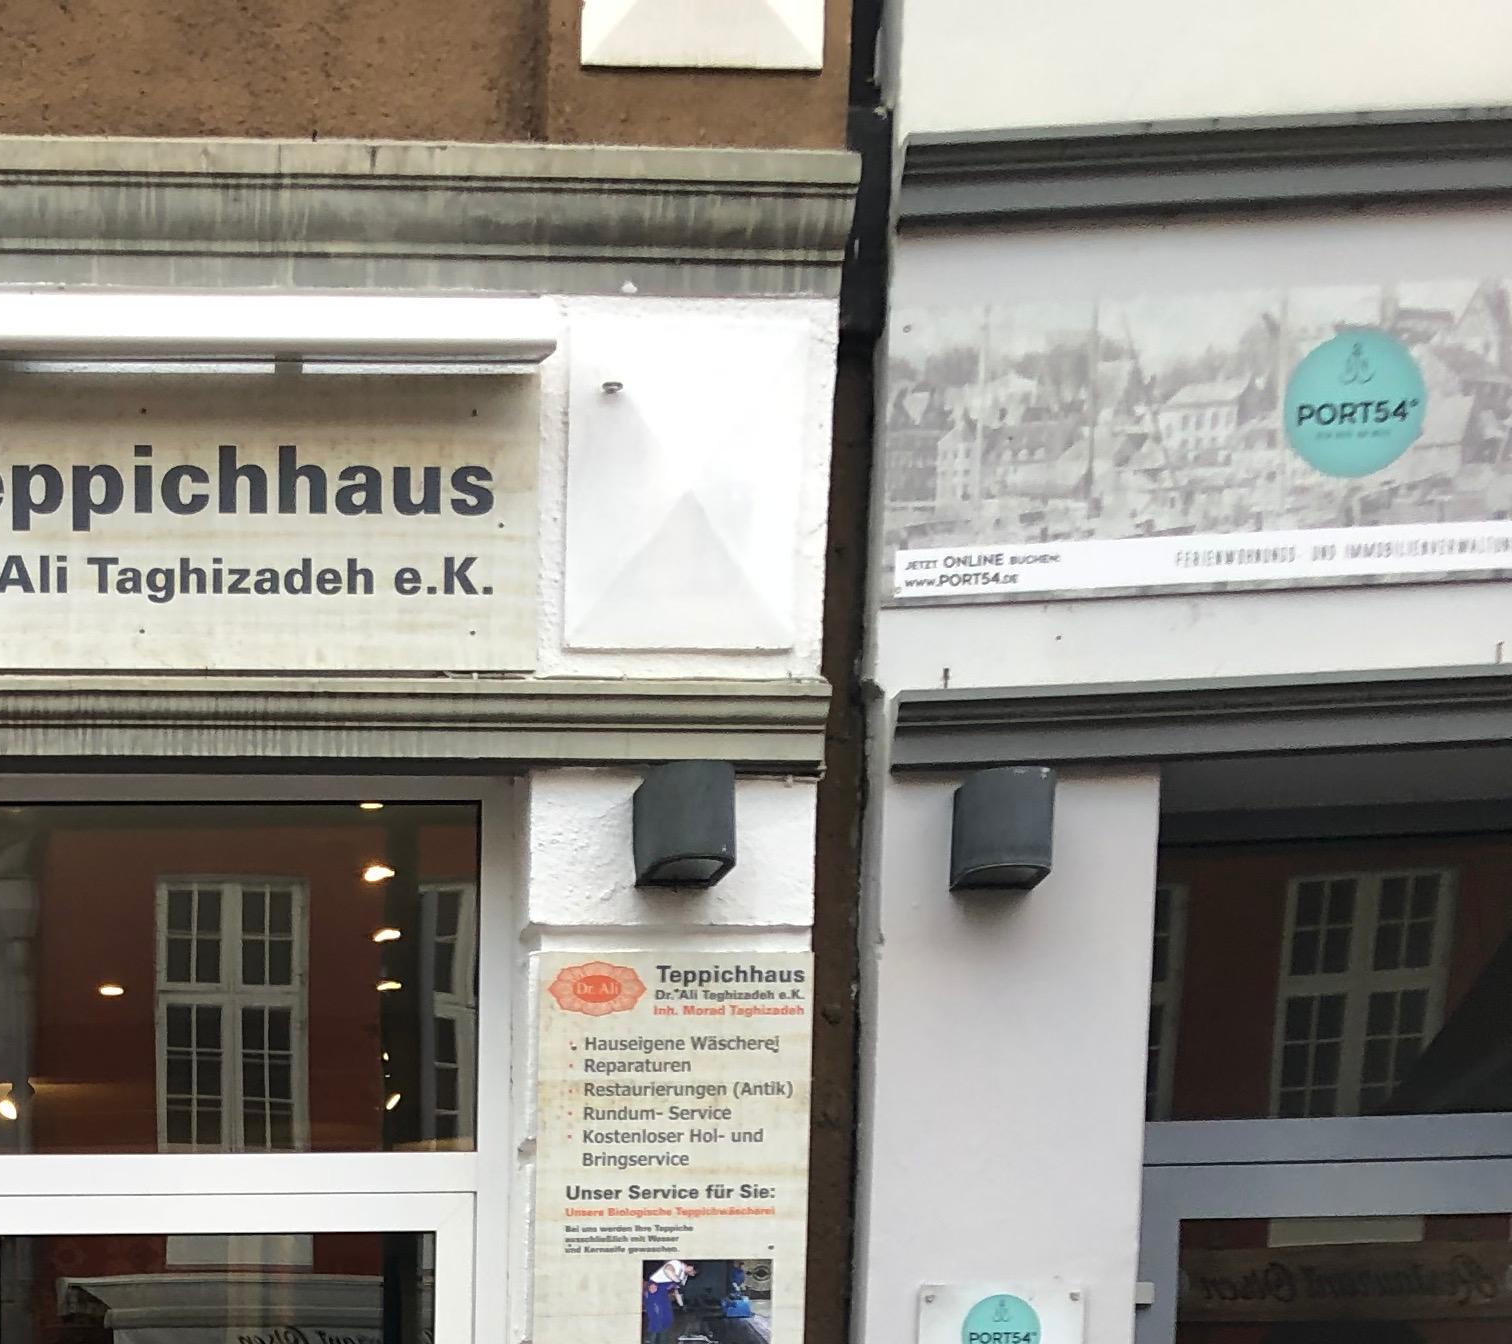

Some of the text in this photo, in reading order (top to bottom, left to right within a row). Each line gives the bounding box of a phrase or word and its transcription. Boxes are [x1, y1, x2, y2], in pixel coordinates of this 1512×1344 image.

[904, 559, 938, 571] JETZT
[943, 553, 1004, 568] ONLINE
[87, 556, 374, 603] Taghizadeh
[394, 556, 494, 595] e.K.
[656, 965, 806, 986] Teppichhaus
[601, 982, 619, 995] Ali
[654, 989, 675, 1000] Dr.
[677, 989, 698, 1000] Ali
[703, 989, 775, 1002] Taghizadeh
[653, 1004, 805, 1018] Inh. Morad Taghizadeh
[584, 1035, 780, 1054] Hauseigene Wäscherei
[584, 1058, 691, 1075] Reparaturen
[584, 1081, 794, 1099] Restaurierungen (Antik)
[583, 1106, 732, 1121] Rundum- Service
[582, 1128, 764, 1144] Kostenloser Hol- und
[582, 1152, 689, 1169] Bringservice
[565, 1184, 776, 1200] Unser Service für Sie:
[565, 1207, 604, 1217] Unsere
[608, 1207, 672, 1218] Biologische
